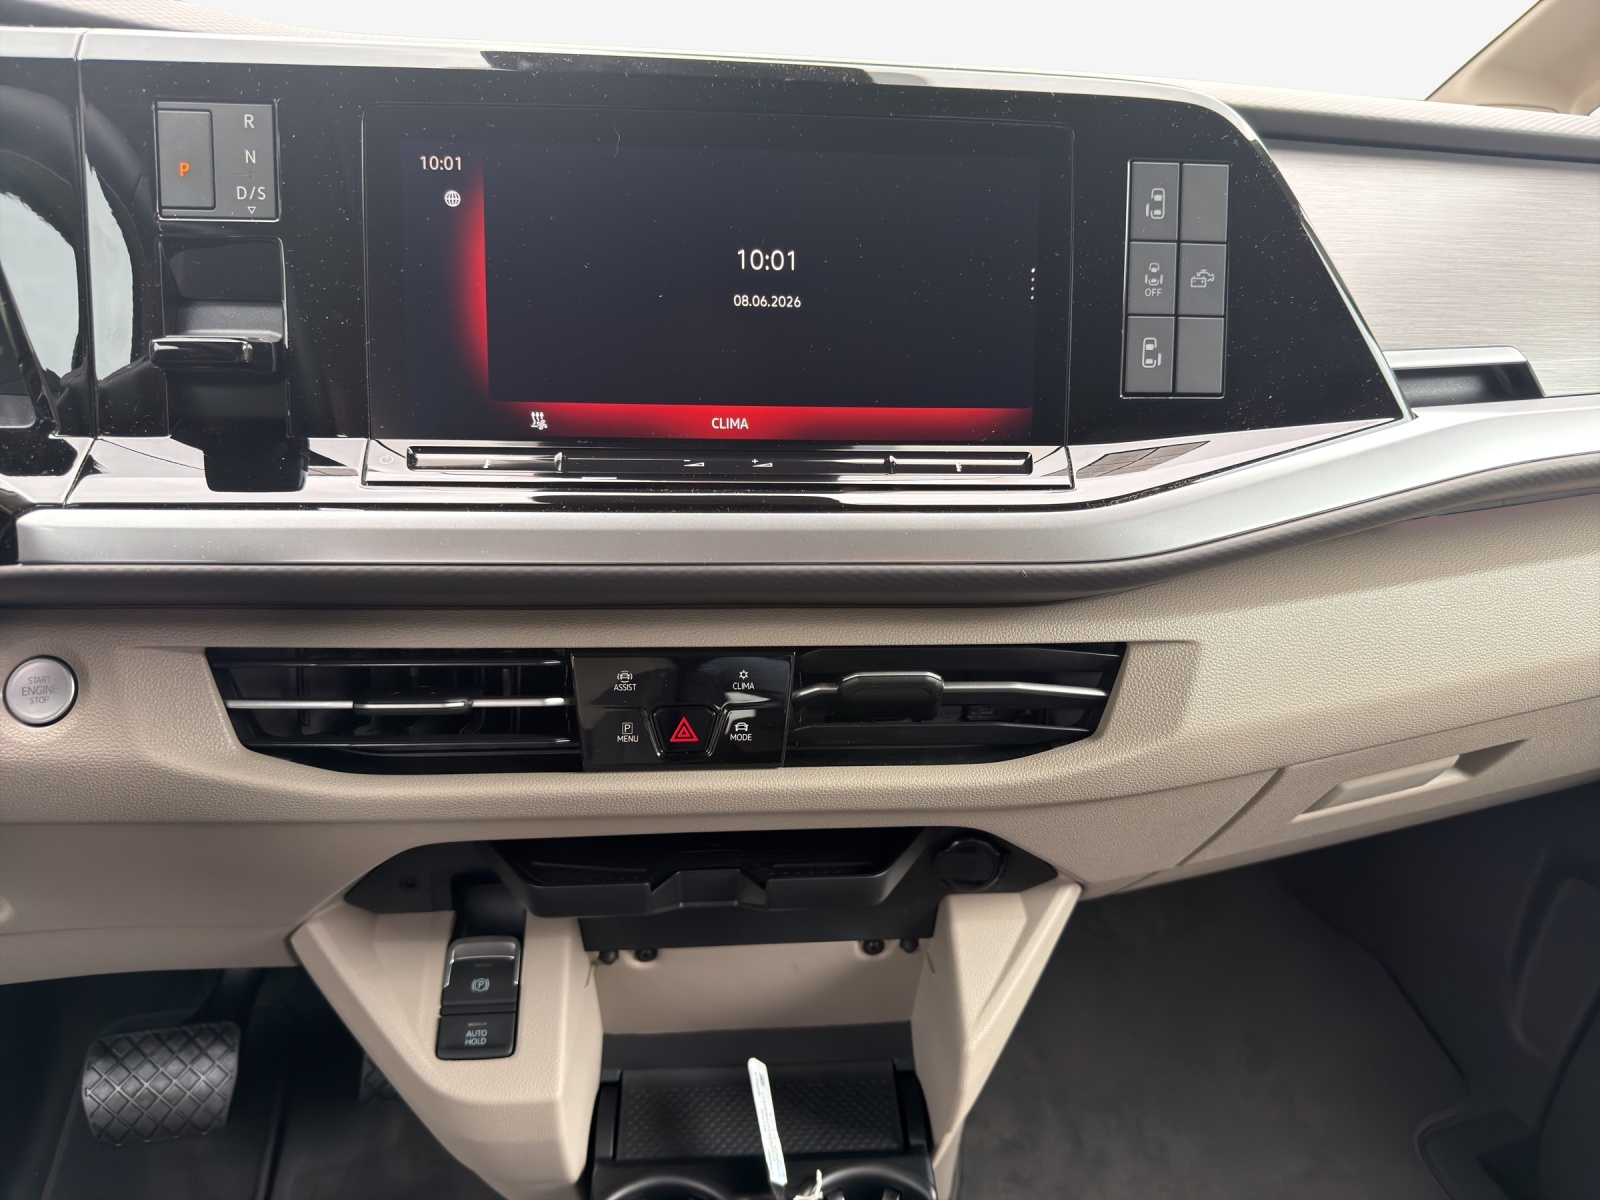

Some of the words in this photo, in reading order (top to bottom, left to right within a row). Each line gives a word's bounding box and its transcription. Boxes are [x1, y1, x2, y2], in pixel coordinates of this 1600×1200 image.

[244, 113, 255, 129] R
[245, 149, 256, 164] N
[420, 155, 462, 171] 10:01
[179, 162, 191, 178] P
[236, 185, 266, 200] D/S
[737, 248, 795, 271] 10:01
[1144, 288, 1163, 297] OFF
[733, 294, 802, 308] 08.06.2026
[711, 417, 749, 430] CLIMA
[28, 675, 51, 684] START
[21, 684, 58, 696] ENGINE
[613, 683, 637, 691] ASSIST
[732, 682, 755, 690] CLIMA
[29, 696, 50, 704] STOP
[616, 735, 639, 743] MENU
[729, 733, 752, 741] MODE
[465, 1029, 488, 1037] AUTO
[464, 1037, 487, 1046] HOLD
